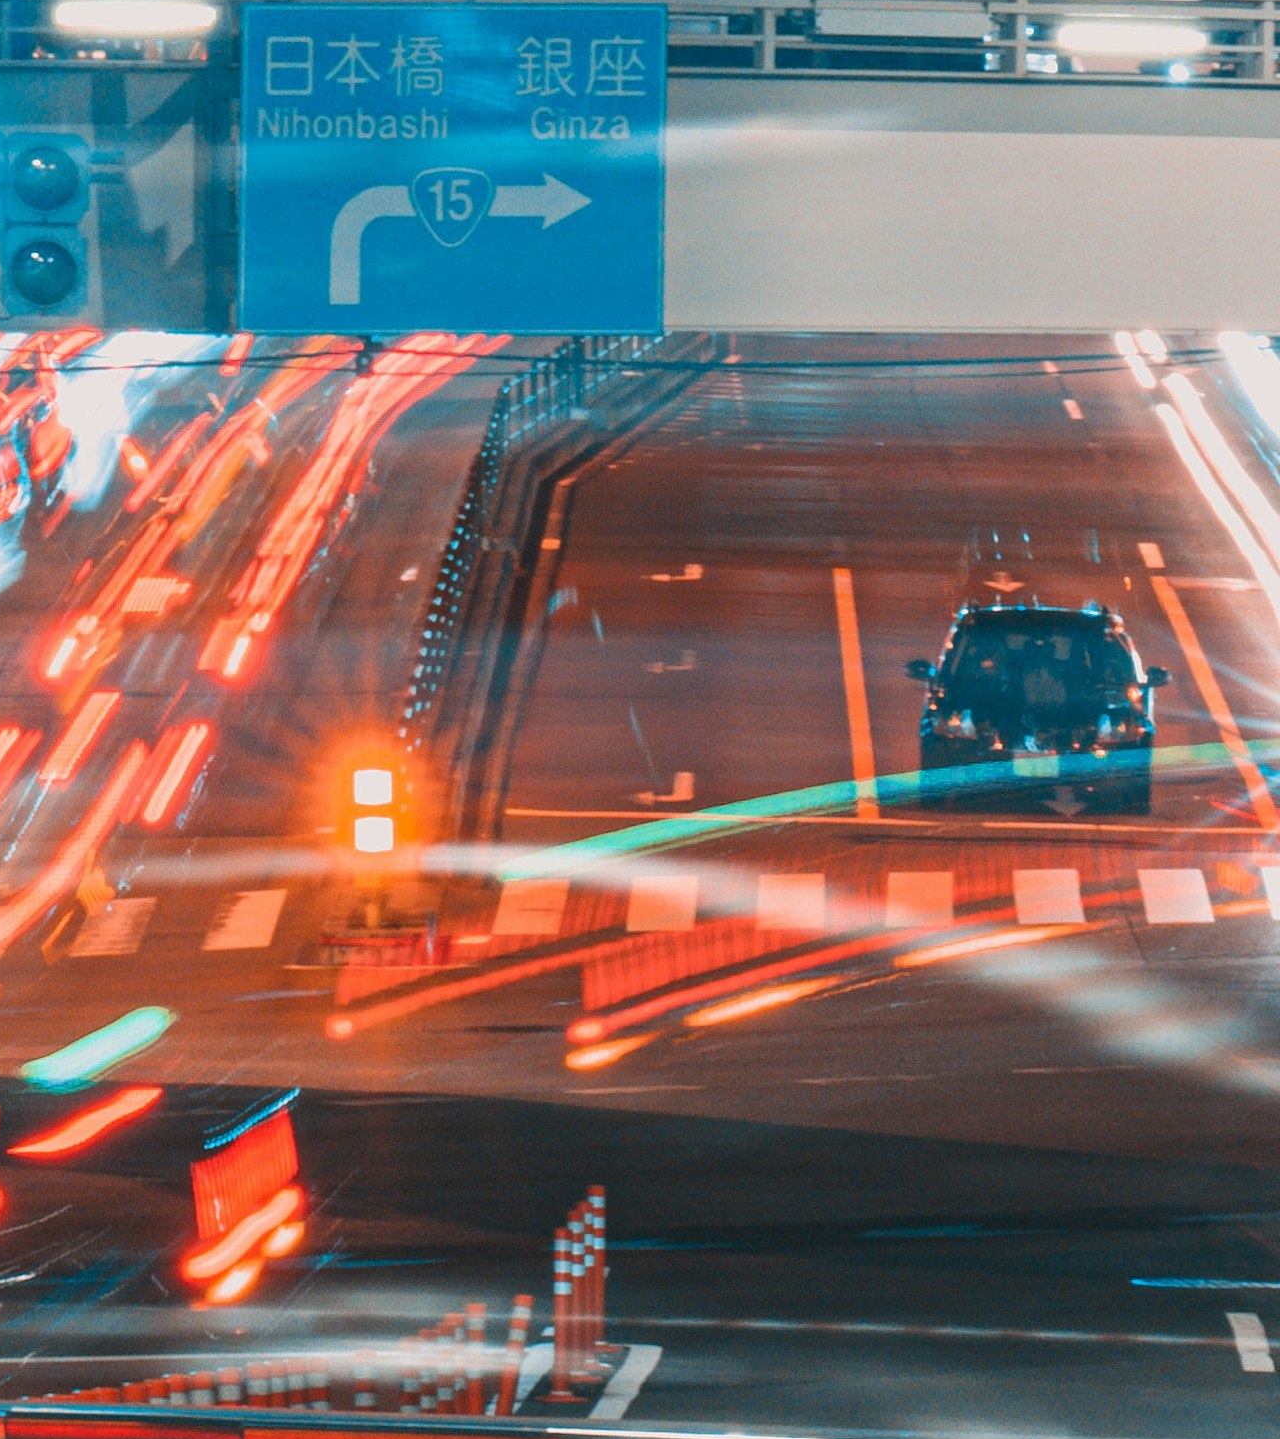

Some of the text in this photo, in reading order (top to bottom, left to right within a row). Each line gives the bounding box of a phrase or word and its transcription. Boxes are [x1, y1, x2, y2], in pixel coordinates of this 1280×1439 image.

[265, 33, 648, 98] 日本橋 銀座
[255, 105, 633, 141] Nihonbashi Ginza
[427, 178, 475, 223] 15
